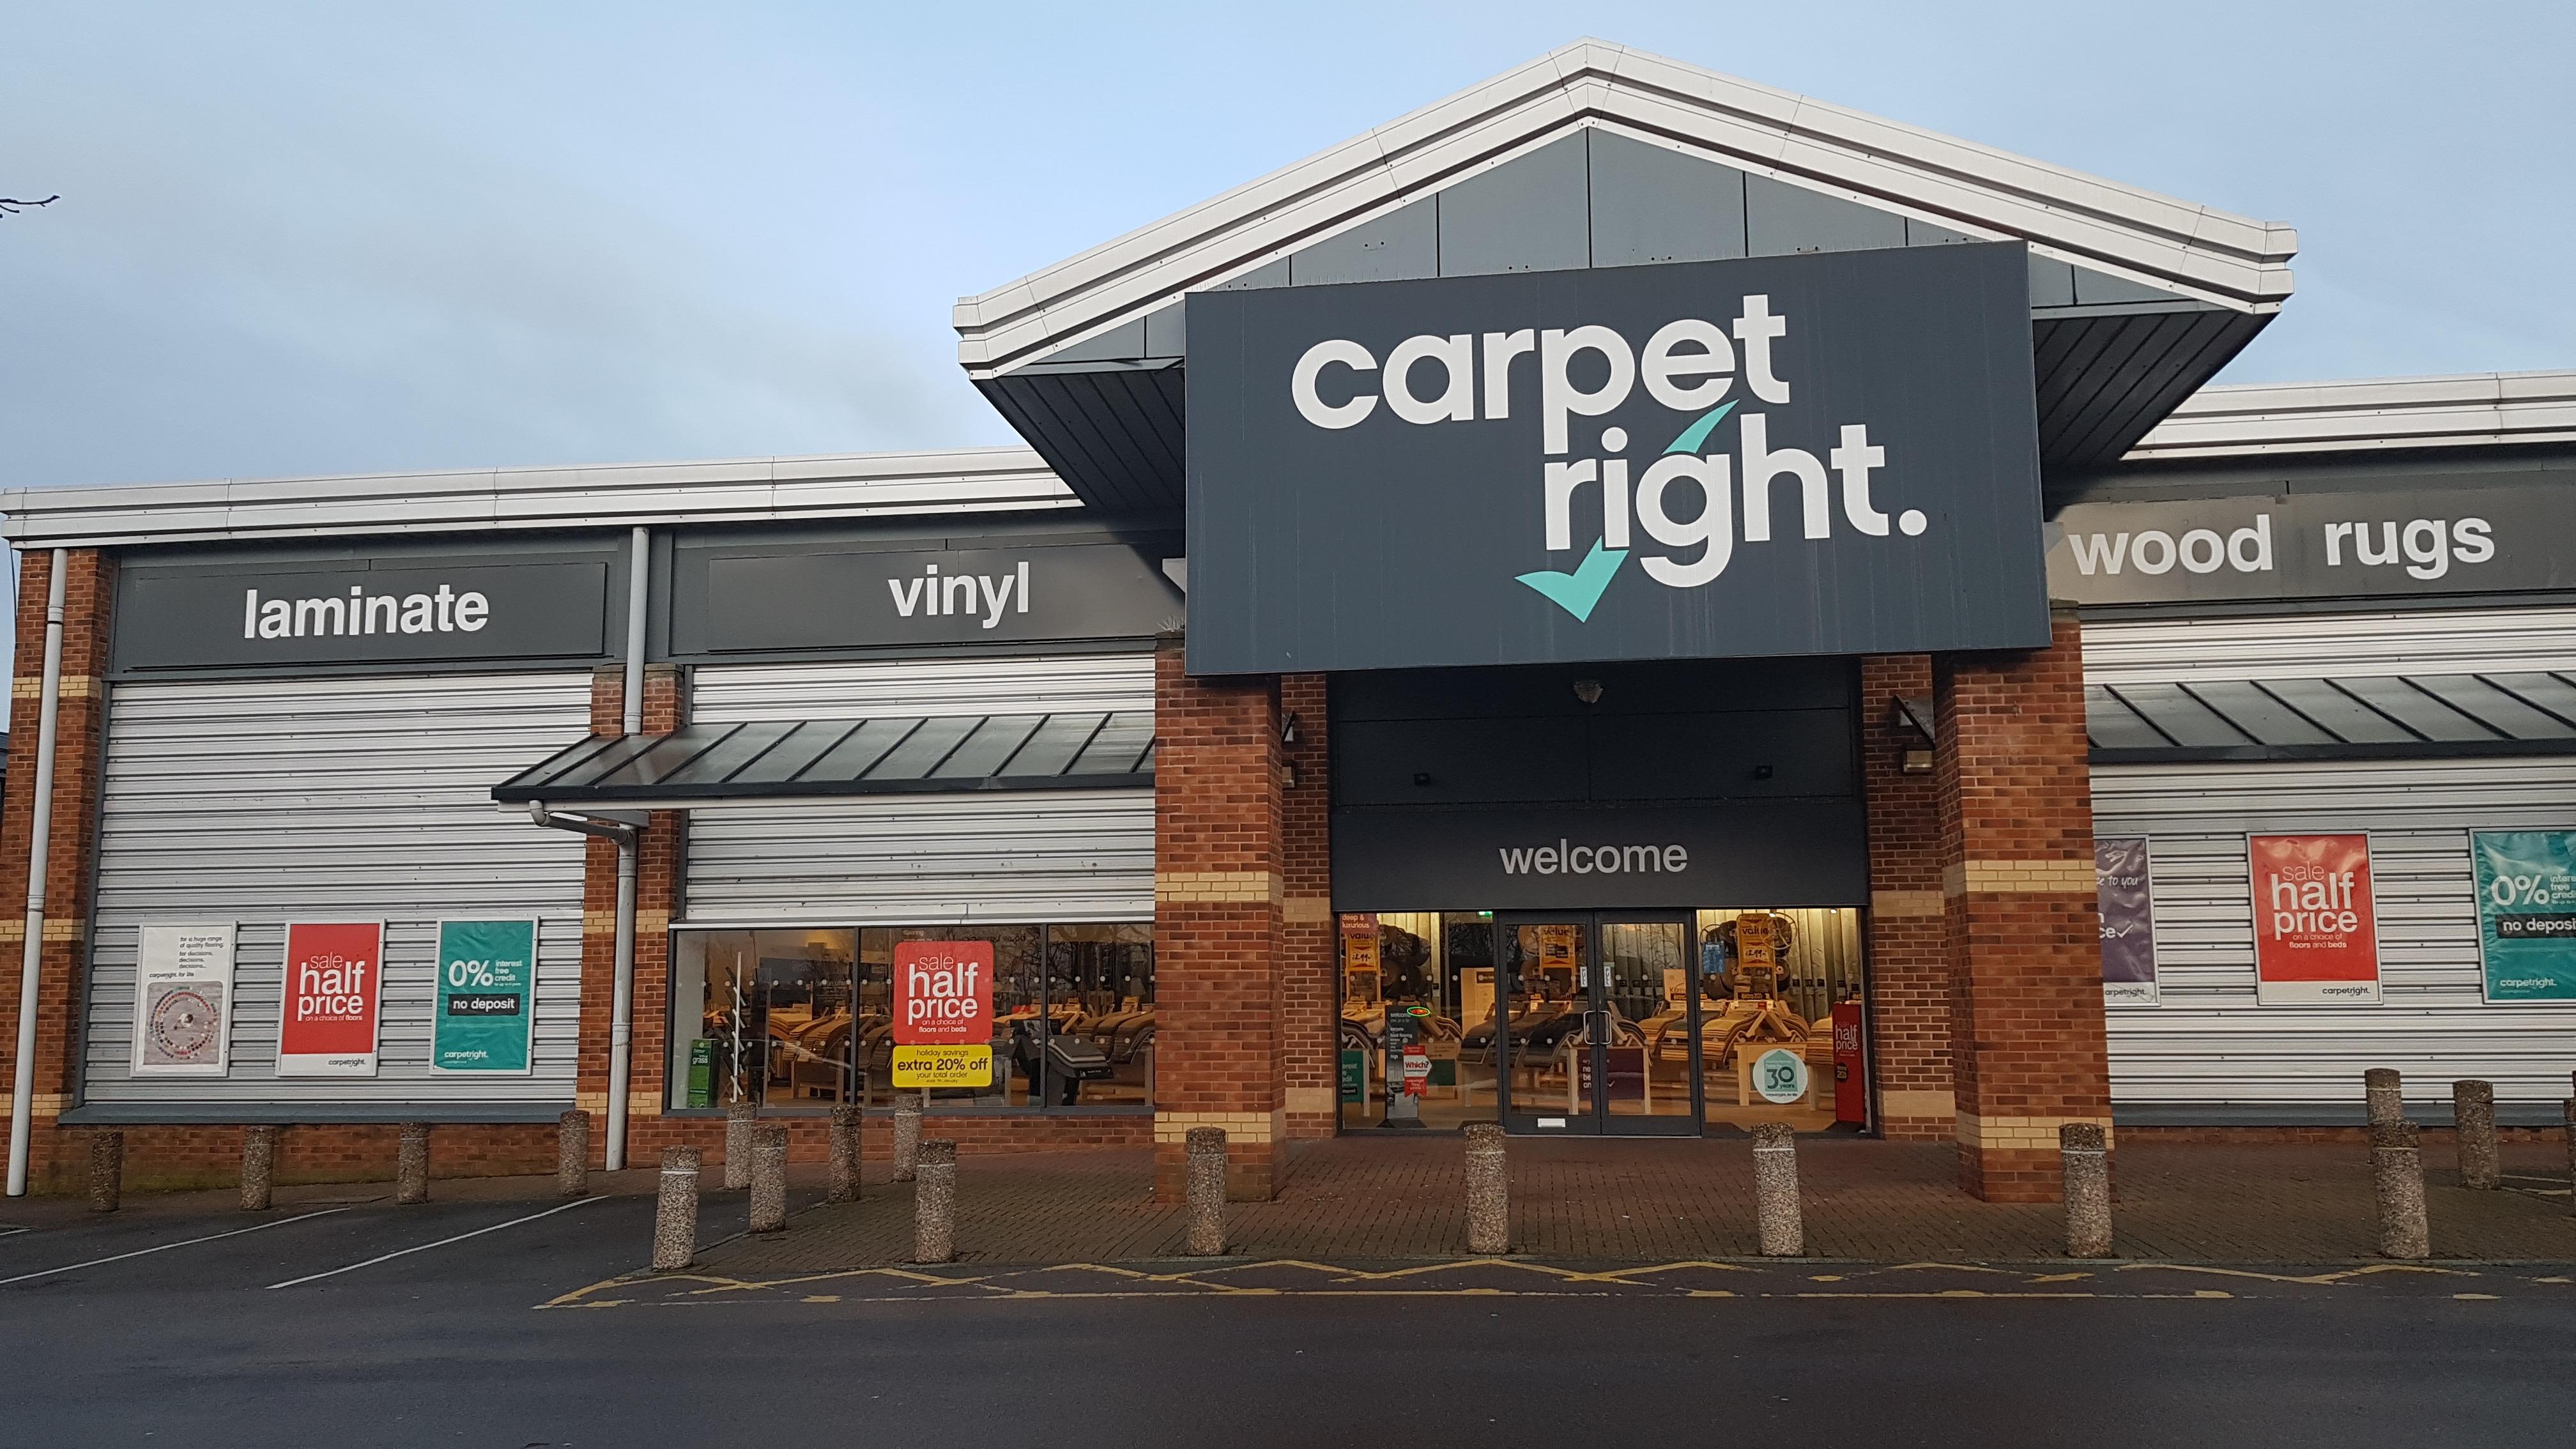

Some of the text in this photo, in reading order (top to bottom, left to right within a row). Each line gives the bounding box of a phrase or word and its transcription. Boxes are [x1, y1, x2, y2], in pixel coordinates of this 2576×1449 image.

[1291, 294, 1790, 455] carpet
[2068, 514, 2495, 580] wood rugs
[887, 561, 1029, 629] vinyl
[244, 584, 489, 639] laminate
[1499, 838, 1688, 875] welcome
[2108, 875, 2118, 886] to
[2121, 877, 2138, 889] you
[2282, 861, 2325, 881] sale
[2271, 871, 2355, 910] half
[2490, 875, 2549, 905] 0%
[2274, 911, 2358, 940] price
[2503, 921, 2522, 931] no
[310, 952, 342, 969] sale
[448, 960, 493, 986] 0%
[919, 953, 953, 970] sale
[299, 961, 365, 994] half
[908, 962, 978, 997] half
[297, 995, 364, 1021] price
[453, 998, 515, 1012] no deposit
[908, 997, 978, 1025] price
[1836, 1024, 1857, 1040] half
[1836, 1040, 1858, 1053] price
[898, 1057, 988, 1071] extra 20% off
[1767, 1066, 1794, 1089] 30
